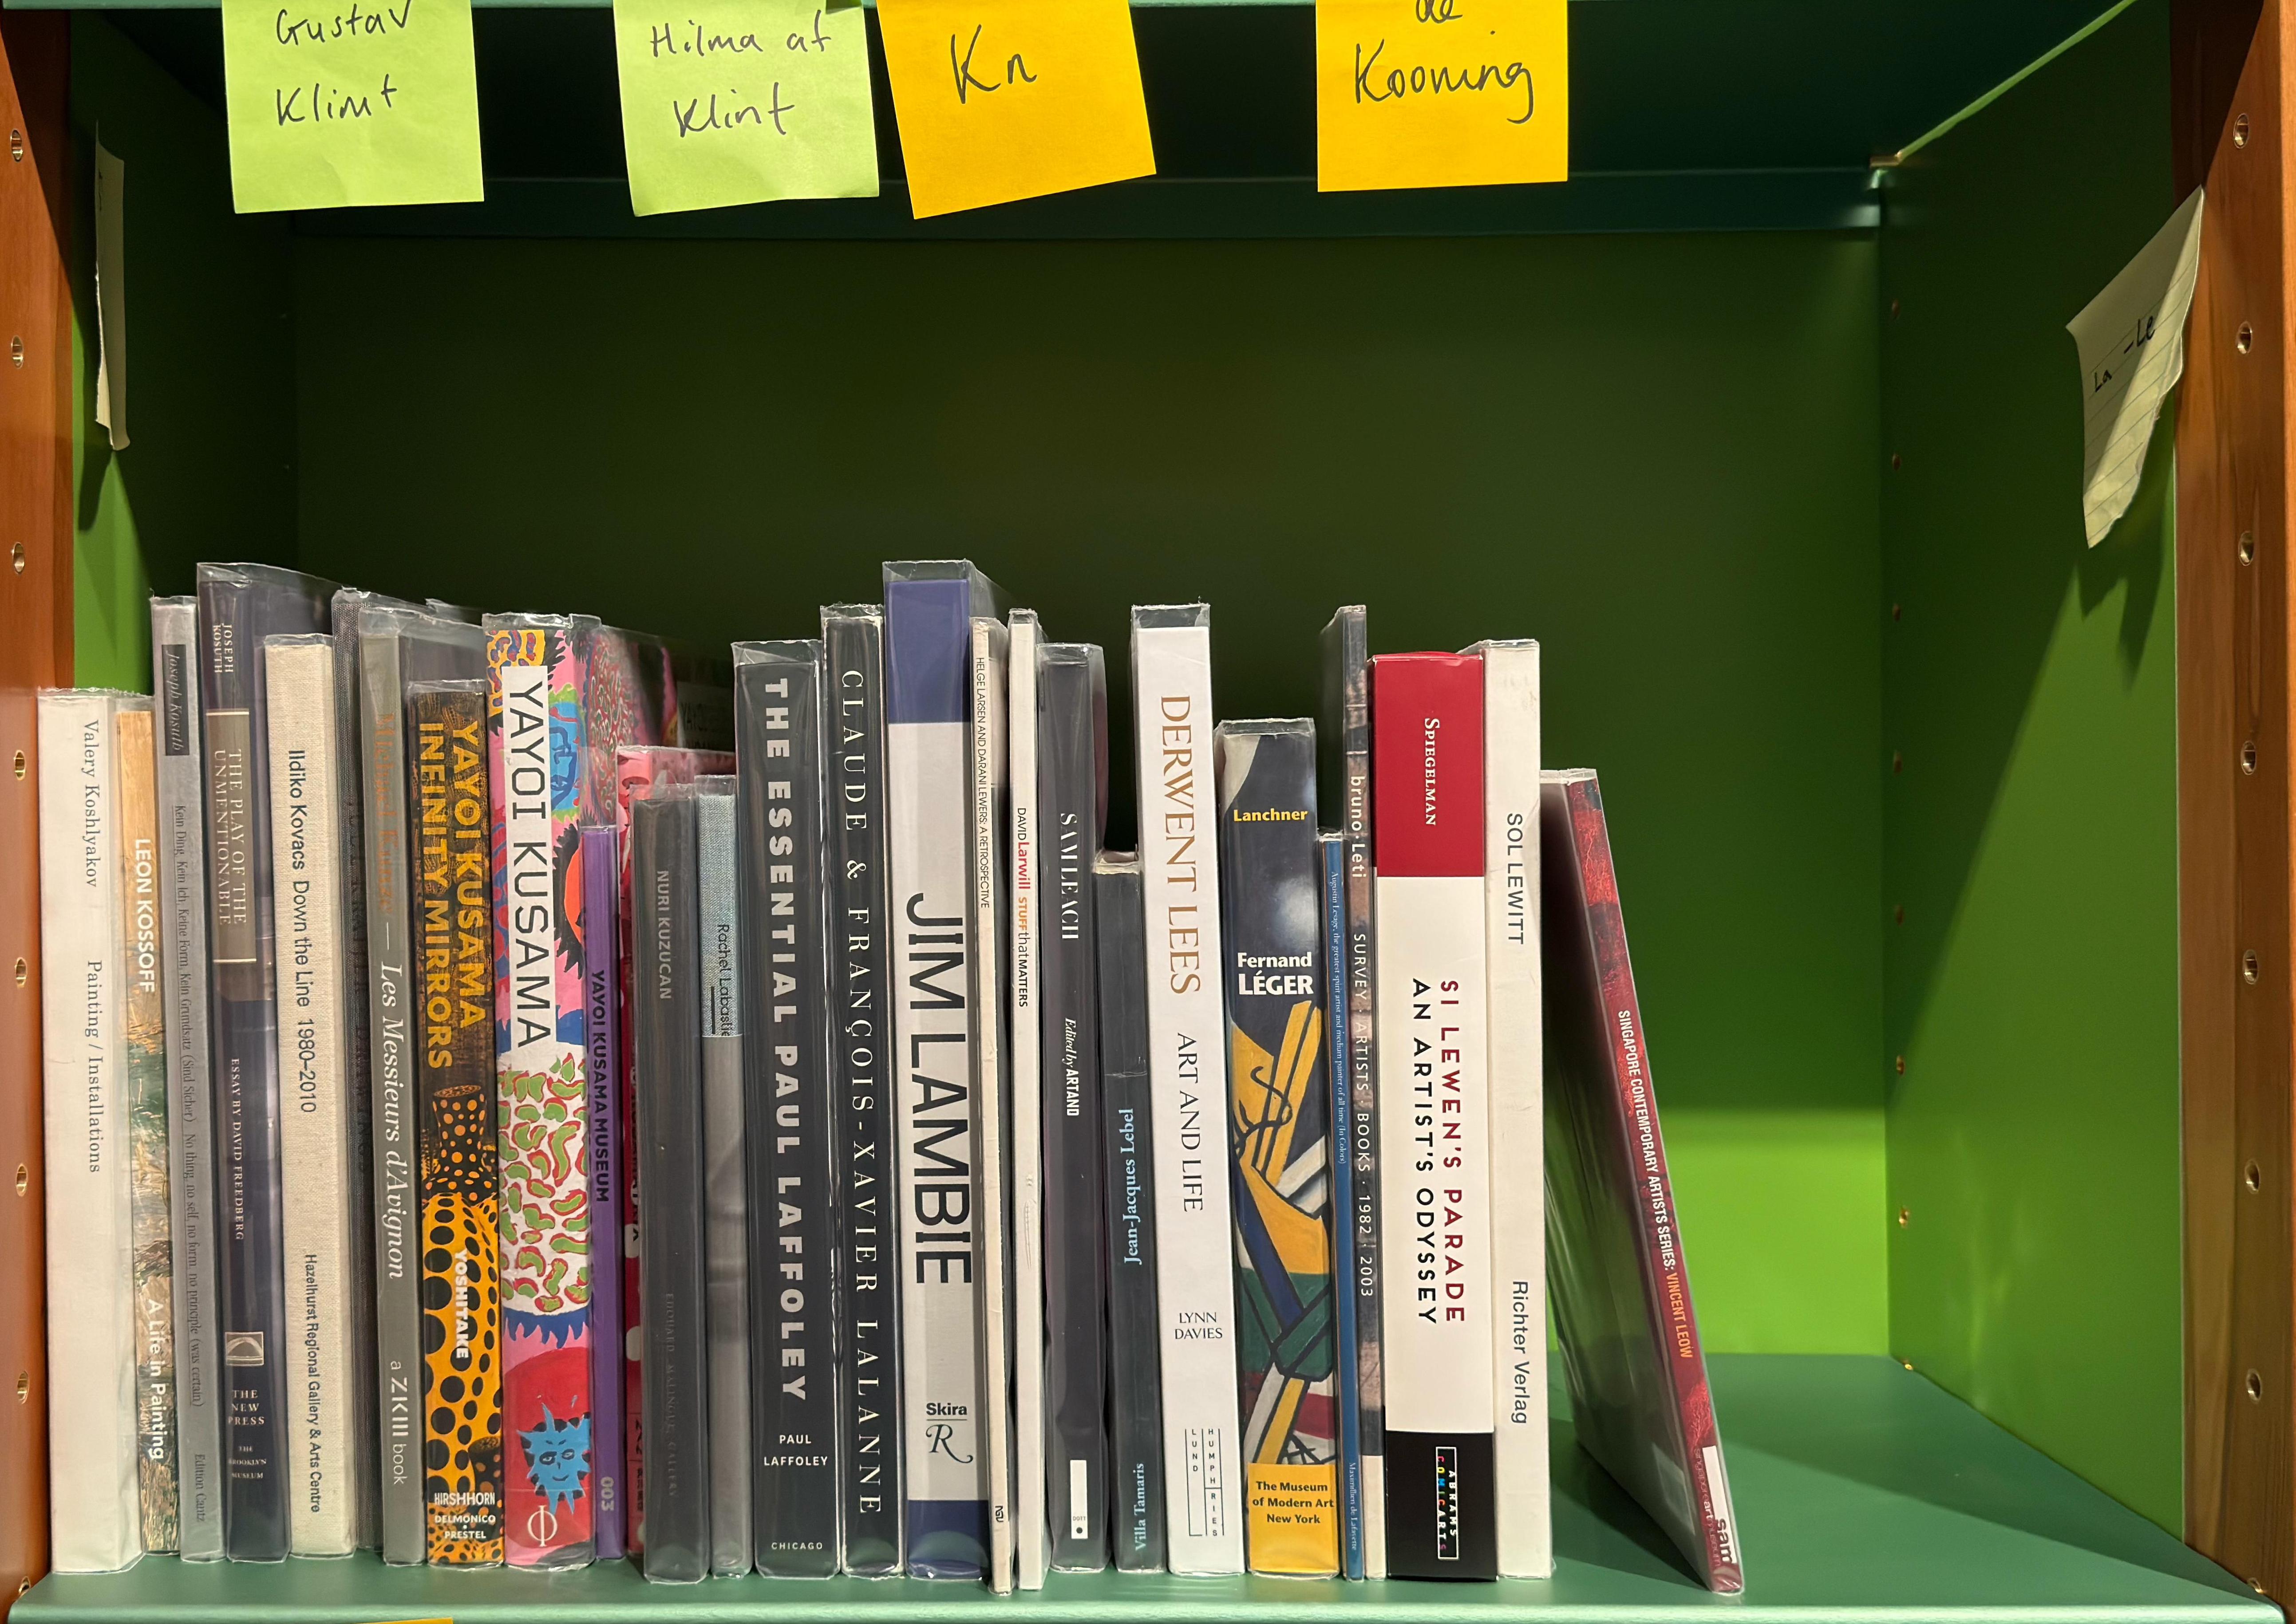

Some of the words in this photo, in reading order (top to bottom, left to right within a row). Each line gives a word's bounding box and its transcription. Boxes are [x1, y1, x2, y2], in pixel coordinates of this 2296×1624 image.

[277, 0, 411, 46] Gustav
[651, 20, 761, 58] Hilma
[786, 10, 833, 53] af
[951, 24, 1038, 104] Kn
[1356, 29, 1535, 124] Kooning
[277, 74, 398, 125] Klimt
[2094, 370, 2112, 393] La
[213, 624, 223, 673] KOSUTH
[223, 623, 233, 673] JOSEPH
[976, 658, 985, 686] HELGE
[170, 703, 183, 750] Kosuth
[765, 678, 790, 758] THE
[977, 688, 986, 722] LARSEN
[81, 721, 99, 777] Valery
[510, 681, 546, 820] YAYOI
[842, 671, 866, 831] CLAUDE
[977, 725, 986, 746] AND
[229, 749, 243, 790] THE
[288, 750, 306, 798] Ildiko
[374, 712, 396, 817] Michael
[453, 721, 483, 837] YAYOI
[978, 749, 987, 785] DARANI
[419, 724, 447, 888] INFINITY
[978, 788, 988, 824] LEWERS:
[1161, 695, 1197, 891] DERWENT
[1233, 809, 1308, 821] Lanchner
[81, 785, 100, 887] Koshlyakov
[213, 750, 232, 925] UNMENTIONABLE
[230, 799, 245, 842] PLAY
[290, 804, 308, 869] Kovacs
[1060, 813, 1078, 865] SAM
[1507, 813, 1522, 855] SOL
[134, 839, 152, 893] LEON
[232, 851, 245, 875] OF
[846, 860, 867, 879] &
[979, 836, 989, 908] RETROSPECTIVE
[233, 883, 247, 924] THE
[292, 881, 309, 931] Down
[656, 871, 670, 911] NURI
[768, 781, 797, 1023] ESSENTIAL
[1061, 867, 1079, 940] LEACH
[1329, 872, 1339, 903] Augustin
[1507, 863, 1524, 945] LEWITT
[178, 909, 190, 935] Keine
[455, 855, 486, 1028] KUSAMA
[514, 842, 550, 1048] KUSAMA
[137, 900, 155, 992] KOSSOFF
[294, 938, 311, 965] the
[657, 917, 672, 999] KUZUCAN
[717, 925, 731, 971] Rachel
[907, 893, 966, 1009] JIM
[1168, 905, 1201, 995] LEES
[1237, 953, 1312, 967] Fernand
[1332, 946, 1340, 973] greatest
[1353, 934, 1367, 999] SURVEY
[85, 960, 102, 1037] Painting
[296, 971, 312, 1006] Line
[380, 962, 402, 1007] Les
[425, 900, 452, 1068] MIRRORS
[591, 970, 606, 1025] YAYOI
[1238, 972, 1314, 995] LÉGER
[1332, 975, 1341, 993] spirit
[1413, 978, 1431, 1020] AN
[1440, 981, 1458, 1005] SI
[181, 999, 193, 1050] Grundsatz
[1065, 1018, 1076, 1051] Edited
[1336, 1029, 1344, 1059] medium
[1618, 1009, 1642, 1076] SINGAPORE
[231, 1058, 240, 1095] ESSAY
[383, 1016, 405, 1141] Messieurs
[593, 1032, 608, 1112] KUSAMA
[1063, 1054, 1077, 1067] by
[1177, 1033, 1198, 1085] ART
[1336, 1061, 1345, 1085] painter
[1355, 1023, 1368, 1091] ARTISTS
[88, 1056, 103, 1172] Installations
[183, 1087, 196, 1122] Sicher)
[233, 1101, 242, 1116] BY
[775, 1045, 800, 1153] PAUL
[844, 908, 877, 1292] FRANÇOIS-XAVIER
[1066, 1069, 1079, 1116] ARTAND
[233, 1122, 243, 1160] DAVID
[1119, 1109, 1136, 1153] Lebel
[1180, 1090, 1200, 1150] AND
[1357, 1112, 1370, 1172] BOOKS
[1630, 1080, 1659, 1172] CONTEMPORARY
[595, 1119, 609, 1202] MUSEUM
[911, 1034, 972, 1284] LAMBIE
[1338, 1138, 1347, 1163] Colors)
[234, 1166, 244, 1239] FREEDBERG
[1182, 1159, 1202, 1212] LIFE
[1647, 1176, 1666, 1224] ARTISTS
[1123, 1159, 1141, 1265] Jean-Jacques
[1359, 1195, 1371, 1234] 1982
[1417, 1188, 1436, 1324] ODYSSEY
[1443, 1190, 1464, 1321] PARADE
[1656, 1226, 1675, 1270] SERIES:
[304, 1254, 318, 1320] Hazelhurst
[778, 1176, 806, 1399] LAFFOLEY
[1359, 1256, 1372, 1297] 2003
[1665, 1273, 1685, 1322] VINCENT
[455, 1250, 468, 1357] YOSHITAKE
[1180, 1313, 1217, 1323] LYNN
[1512, 1281, 1529, 1353] Richter
[149, 1321, 165, 1353] Life
[306, 1323, 320, 1376] Regional
[1174, 1328, 1223, 1339] DAVIES
[1676, 1325, 1692, 1358] LEOW
[150, 1360, 165, 1376] in
[190, 1367, 203, 1407] certain)
[232, 1403, 260, 1412] NEW
[233, 1390, 258, 1398] THE
[307, 1381, 320, 1424] Gallery
[926, 1403, 968, 1415] Skira
[1510, 1361, 1530, 1424] Verlag
[148, 1383, 166, 1459] Painting
[228, 1416, 265, 1425] PRESS
[779, 1435, 812, 1444] PAUL
[856, 1321, 881, 1514] LALANNE
[194, 1454, 207, 1490] Edition
[310, 1443, 322, 1467] Arts
[391, 1443, 408, 1485] book
[764, 1457, 828, 1466] LAFFOLEY
[195, 1493, 208, 1522] Cantz
[310, 1471, 323, 1512] Centre
[434, 1493, 495, 1506] HIRSHHORN
[601, 1476, 614, 1511] 003
[1133, 1463, 1146, 1515] Tamaris
[1252, 1498, 1263, 1507] of
[1255, 1482, 1278, 1490] The
[1281, 1482, 1328, 1490] Museum
[434, 1515, 496, 1524] DELMONICO
[1135, 1519, 1146, 1550] Villa
[1266, 1514, 1284, 1523] New
[1288, 1514, 1321, 1523] York
[1716, 1518, 1733, 1563] sam
